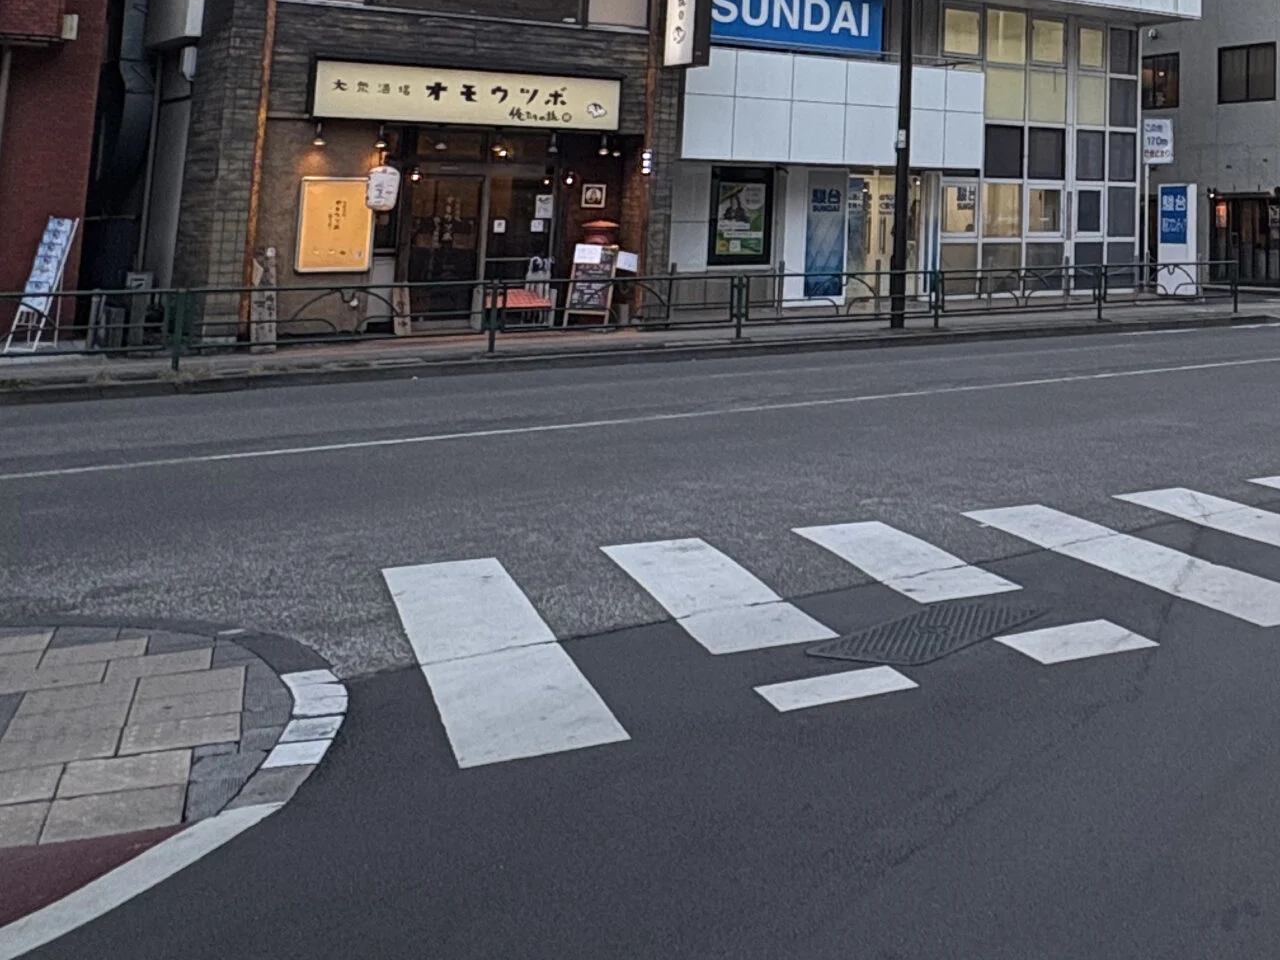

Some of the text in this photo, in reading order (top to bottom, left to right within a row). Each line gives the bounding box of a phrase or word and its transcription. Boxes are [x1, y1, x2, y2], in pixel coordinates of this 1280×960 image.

[331, 78, 412, 97] 大衆酒場
[425, 81, 568, 107] オモウツボ
[1162, 194, 1186, 212] 駿台
